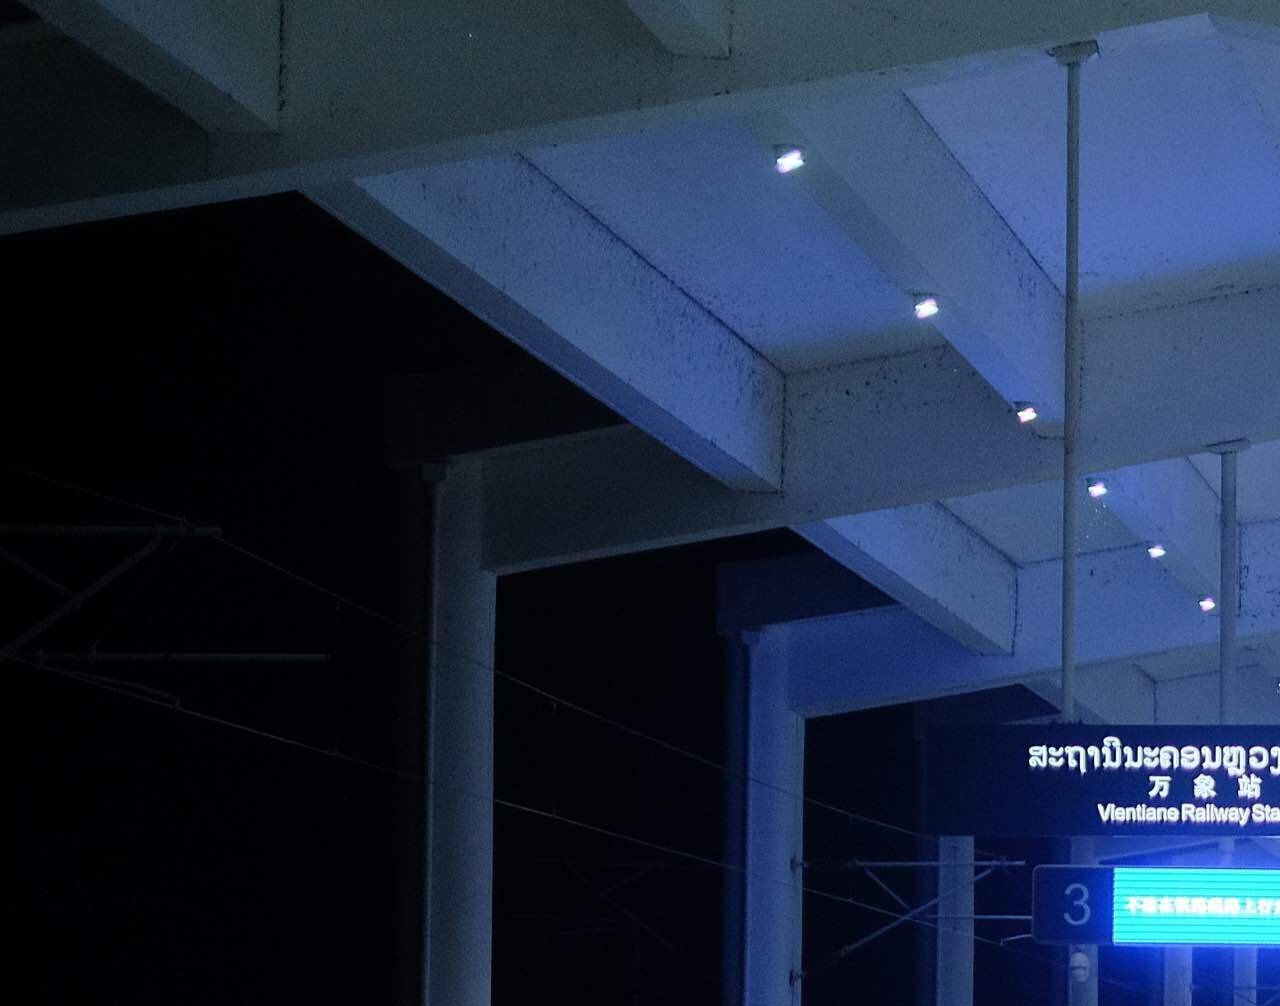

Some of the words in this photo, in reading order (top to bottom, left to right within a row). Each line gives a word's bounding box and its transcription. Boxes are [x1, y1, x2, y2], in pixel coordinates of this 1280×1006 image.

[1149, 774, 1262, 799] 万象站
[1097, 803, 1180, 823] Vientiane
[1181, 803, 1250, 827] Railway
[1064, 883, 1090, 925] 3
